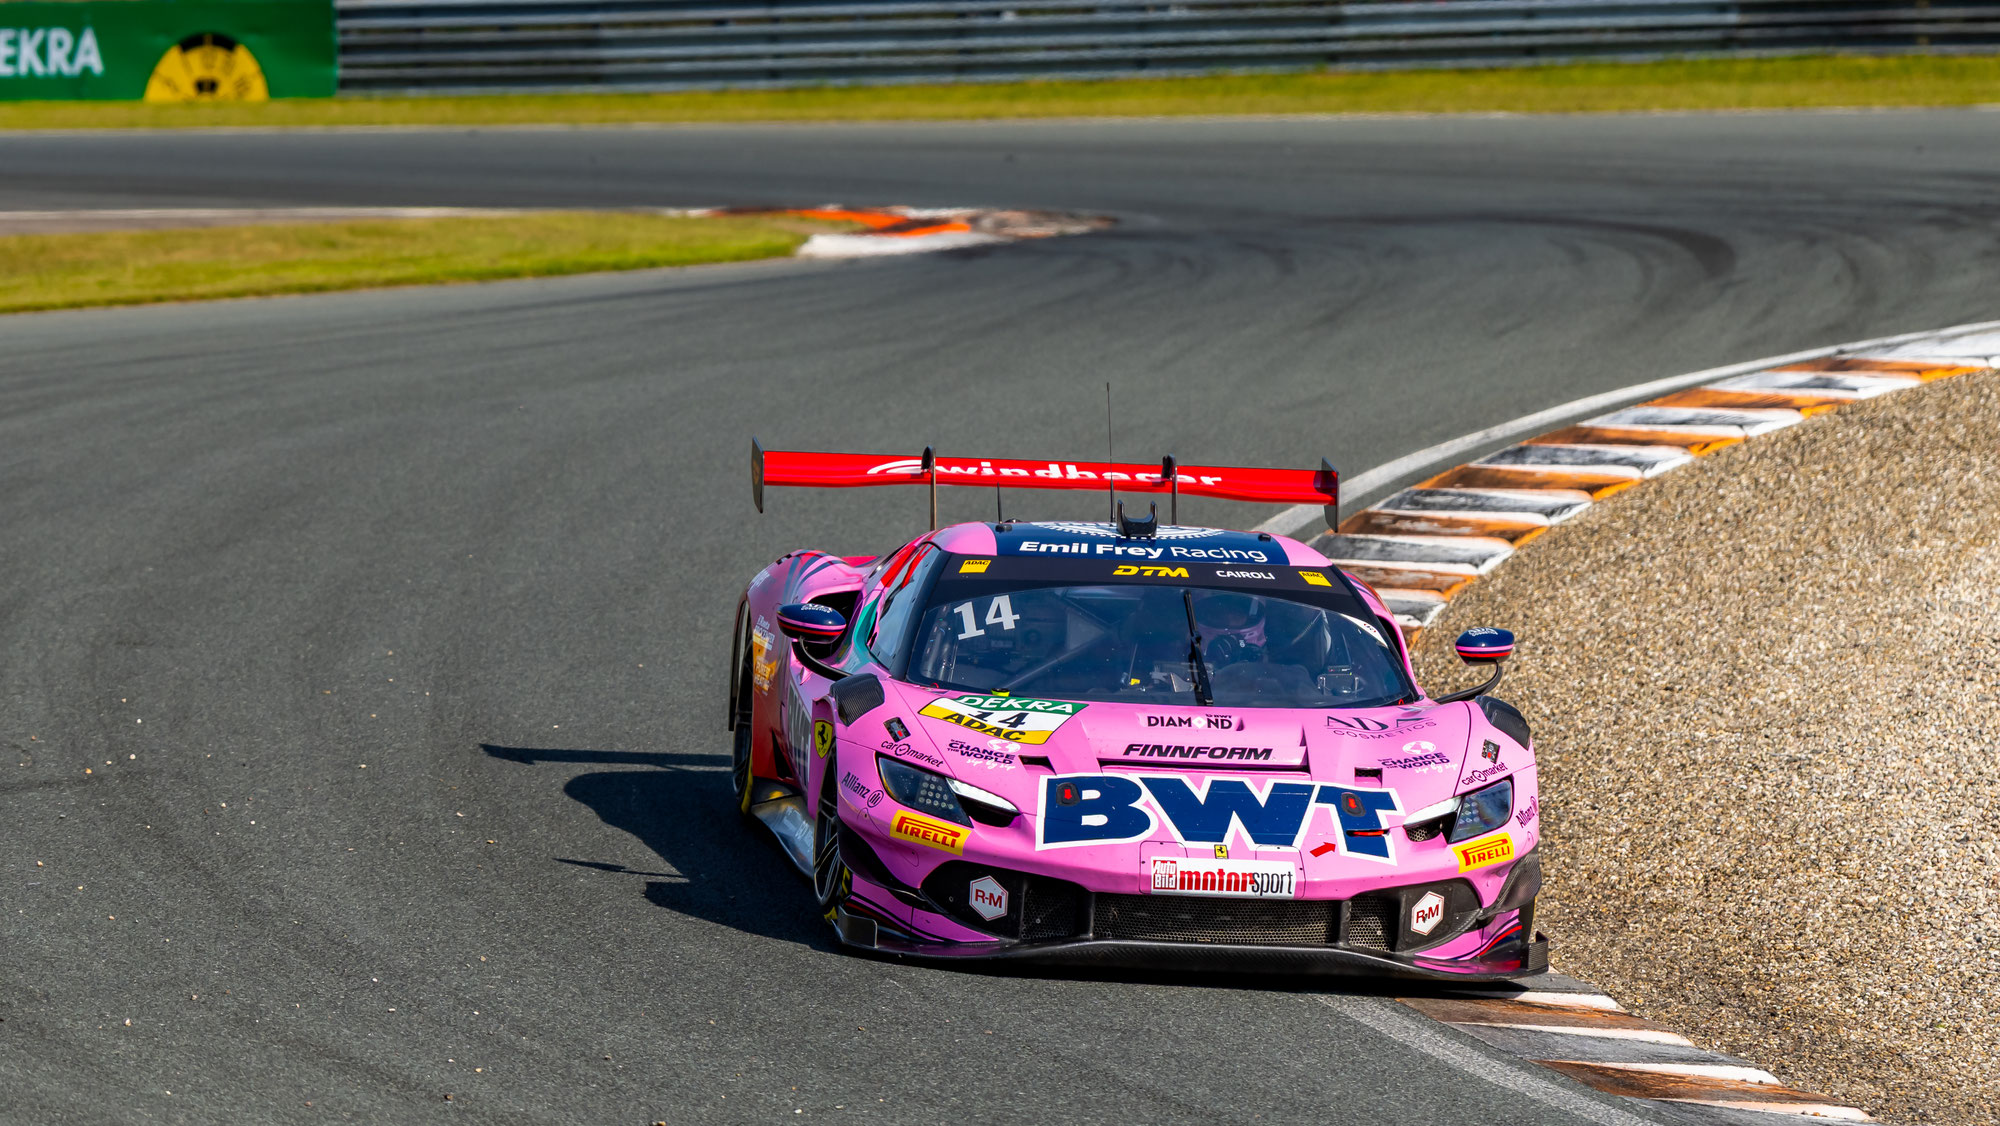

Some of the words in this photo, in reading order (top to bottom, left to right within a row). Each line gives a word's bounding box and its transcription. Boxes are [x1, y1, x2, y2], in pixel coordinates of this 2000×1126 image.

[0, 26, 104, 77] EKRA
[1019, 541, 1088, 554] Emil
[1096, 543, 1164, 559] Frey
[1170, 546, 1269, 563] Racing
[1112, 564, 1190, 578] DTM
[1215, 570, 1275, 580] CAIROLI
[953, 595, 1020, 640] 14
[960, 696, 1074, 714] DEKRA
[942, 712, 1026, 741] ADAC
[967, 710, 1030, 728] 14
[1333, 721, 1437, 740] COSMETICS
[948, 742, 1016, 760] CHANGE
[959, 750, 1013, 765] WORLD
[1381, 752, 1447, 767] CHANGE
[1398, 758, 1450, 770] WORLD
[841, 771, 871, 799] Allianz
[1037, 775, 1405, 864] BWT
[896, 815, 961, 849] PIRELLI
[1460, 838, 1510, 867] PIRELLI
[1153, 860, 1177, 875] Auto
[1154, 874, 1177, 889] Bild
[974, 888, 1003, 909] R-M
